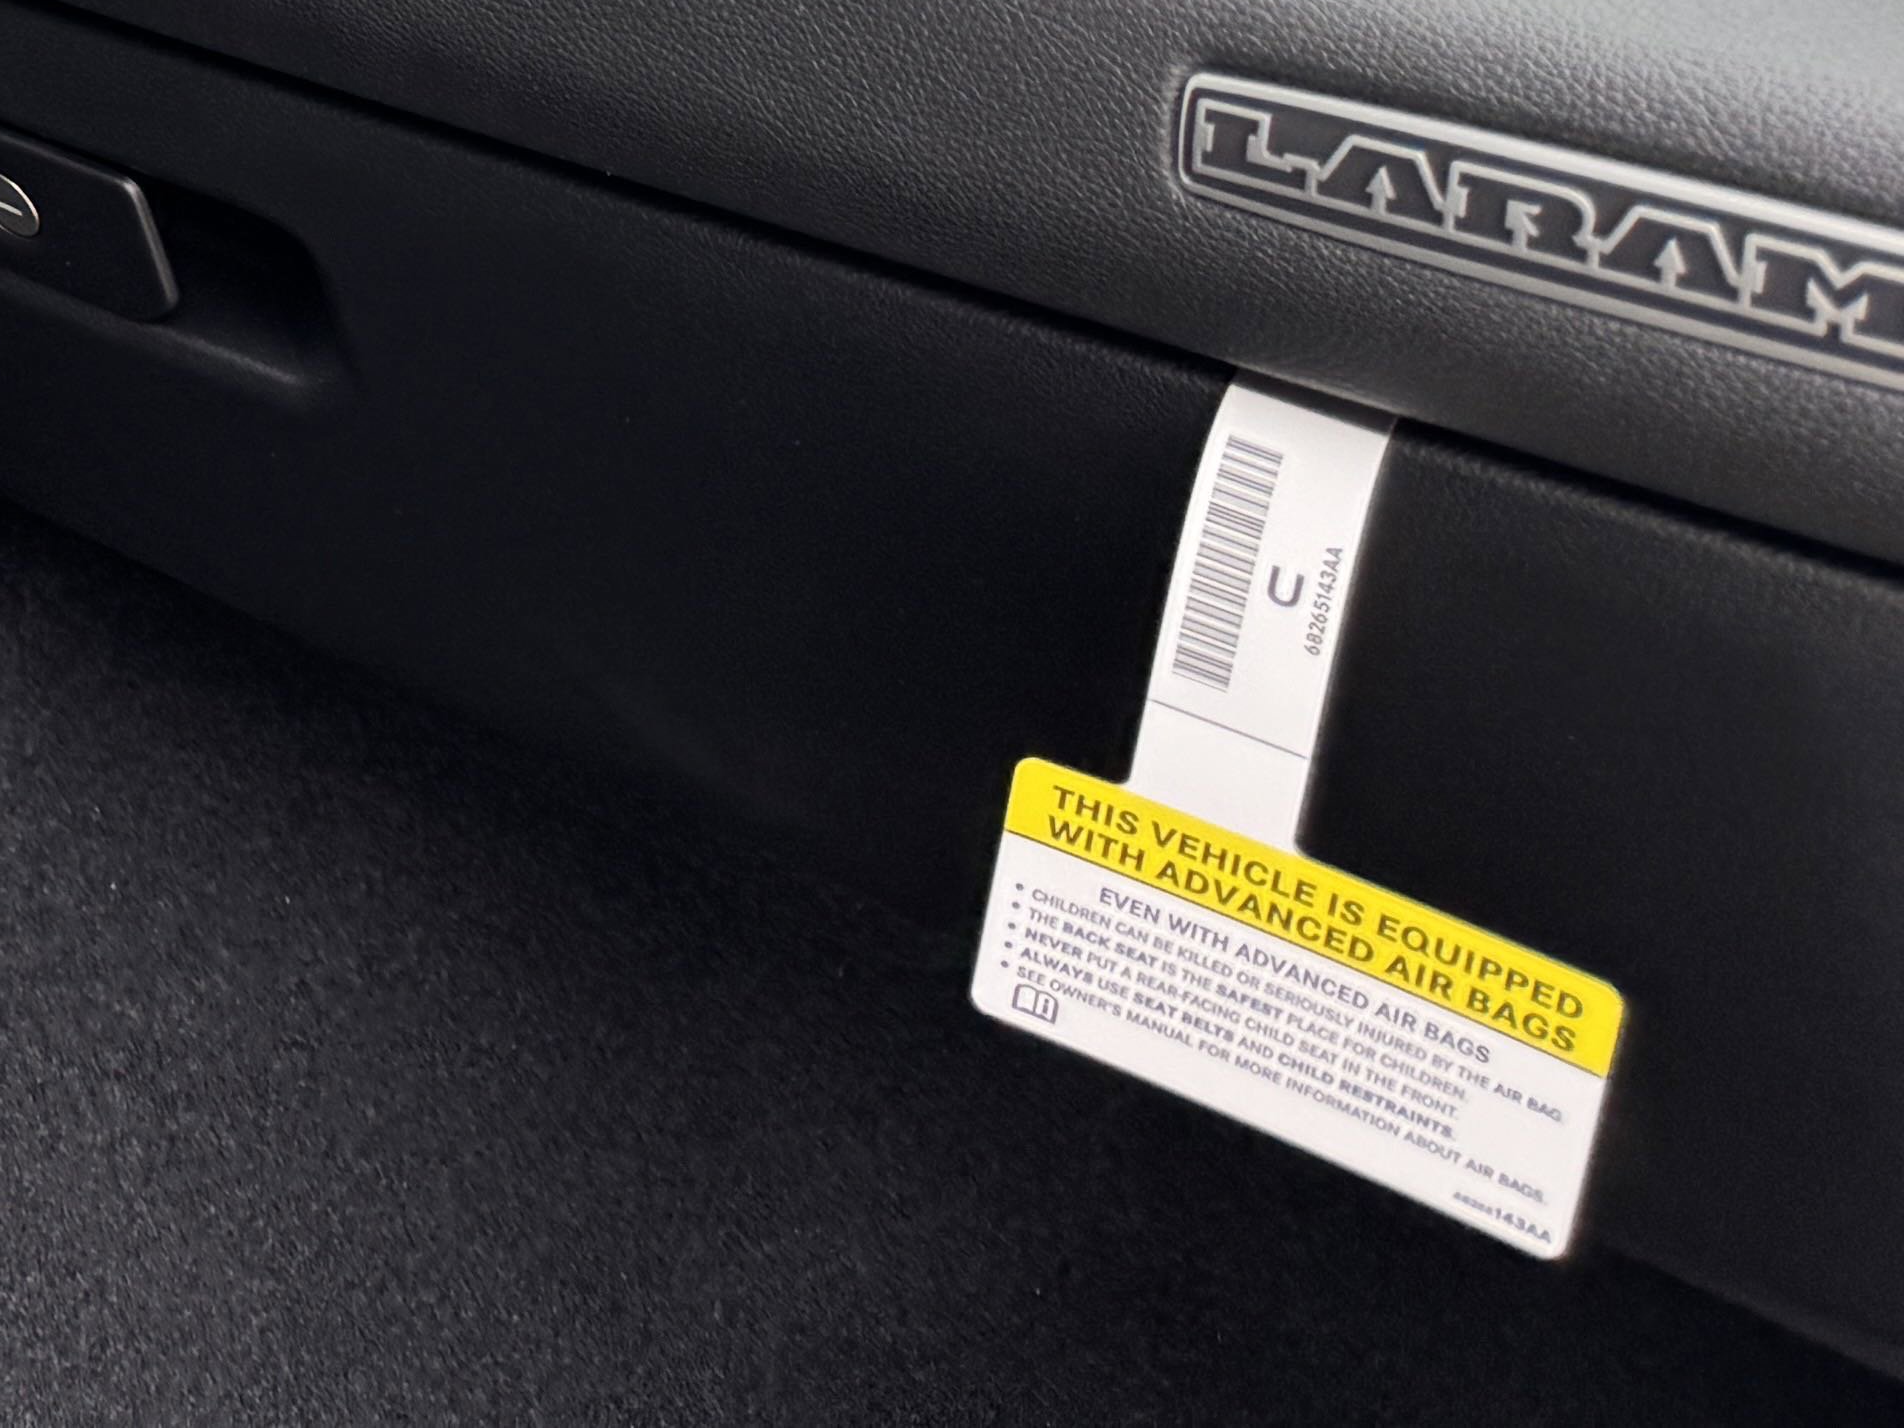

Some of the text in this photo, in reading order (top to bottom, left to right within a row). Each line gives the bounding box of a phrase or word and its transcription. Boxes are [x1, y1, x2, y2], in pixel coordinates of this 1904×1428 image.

[1267, 564, 1305, 608] U
[1302, 546, 1344, 656] 68265143AA
[1048, 815, 1576, 1052] WITH ADVANCED AIR BAGS
[1053, 785, 1583, 1019] THIS VEHICLE IS EQUIPPED
[1099, 886, 1490, 1064] EVEN WITH ADVANCED AIR BAGS
